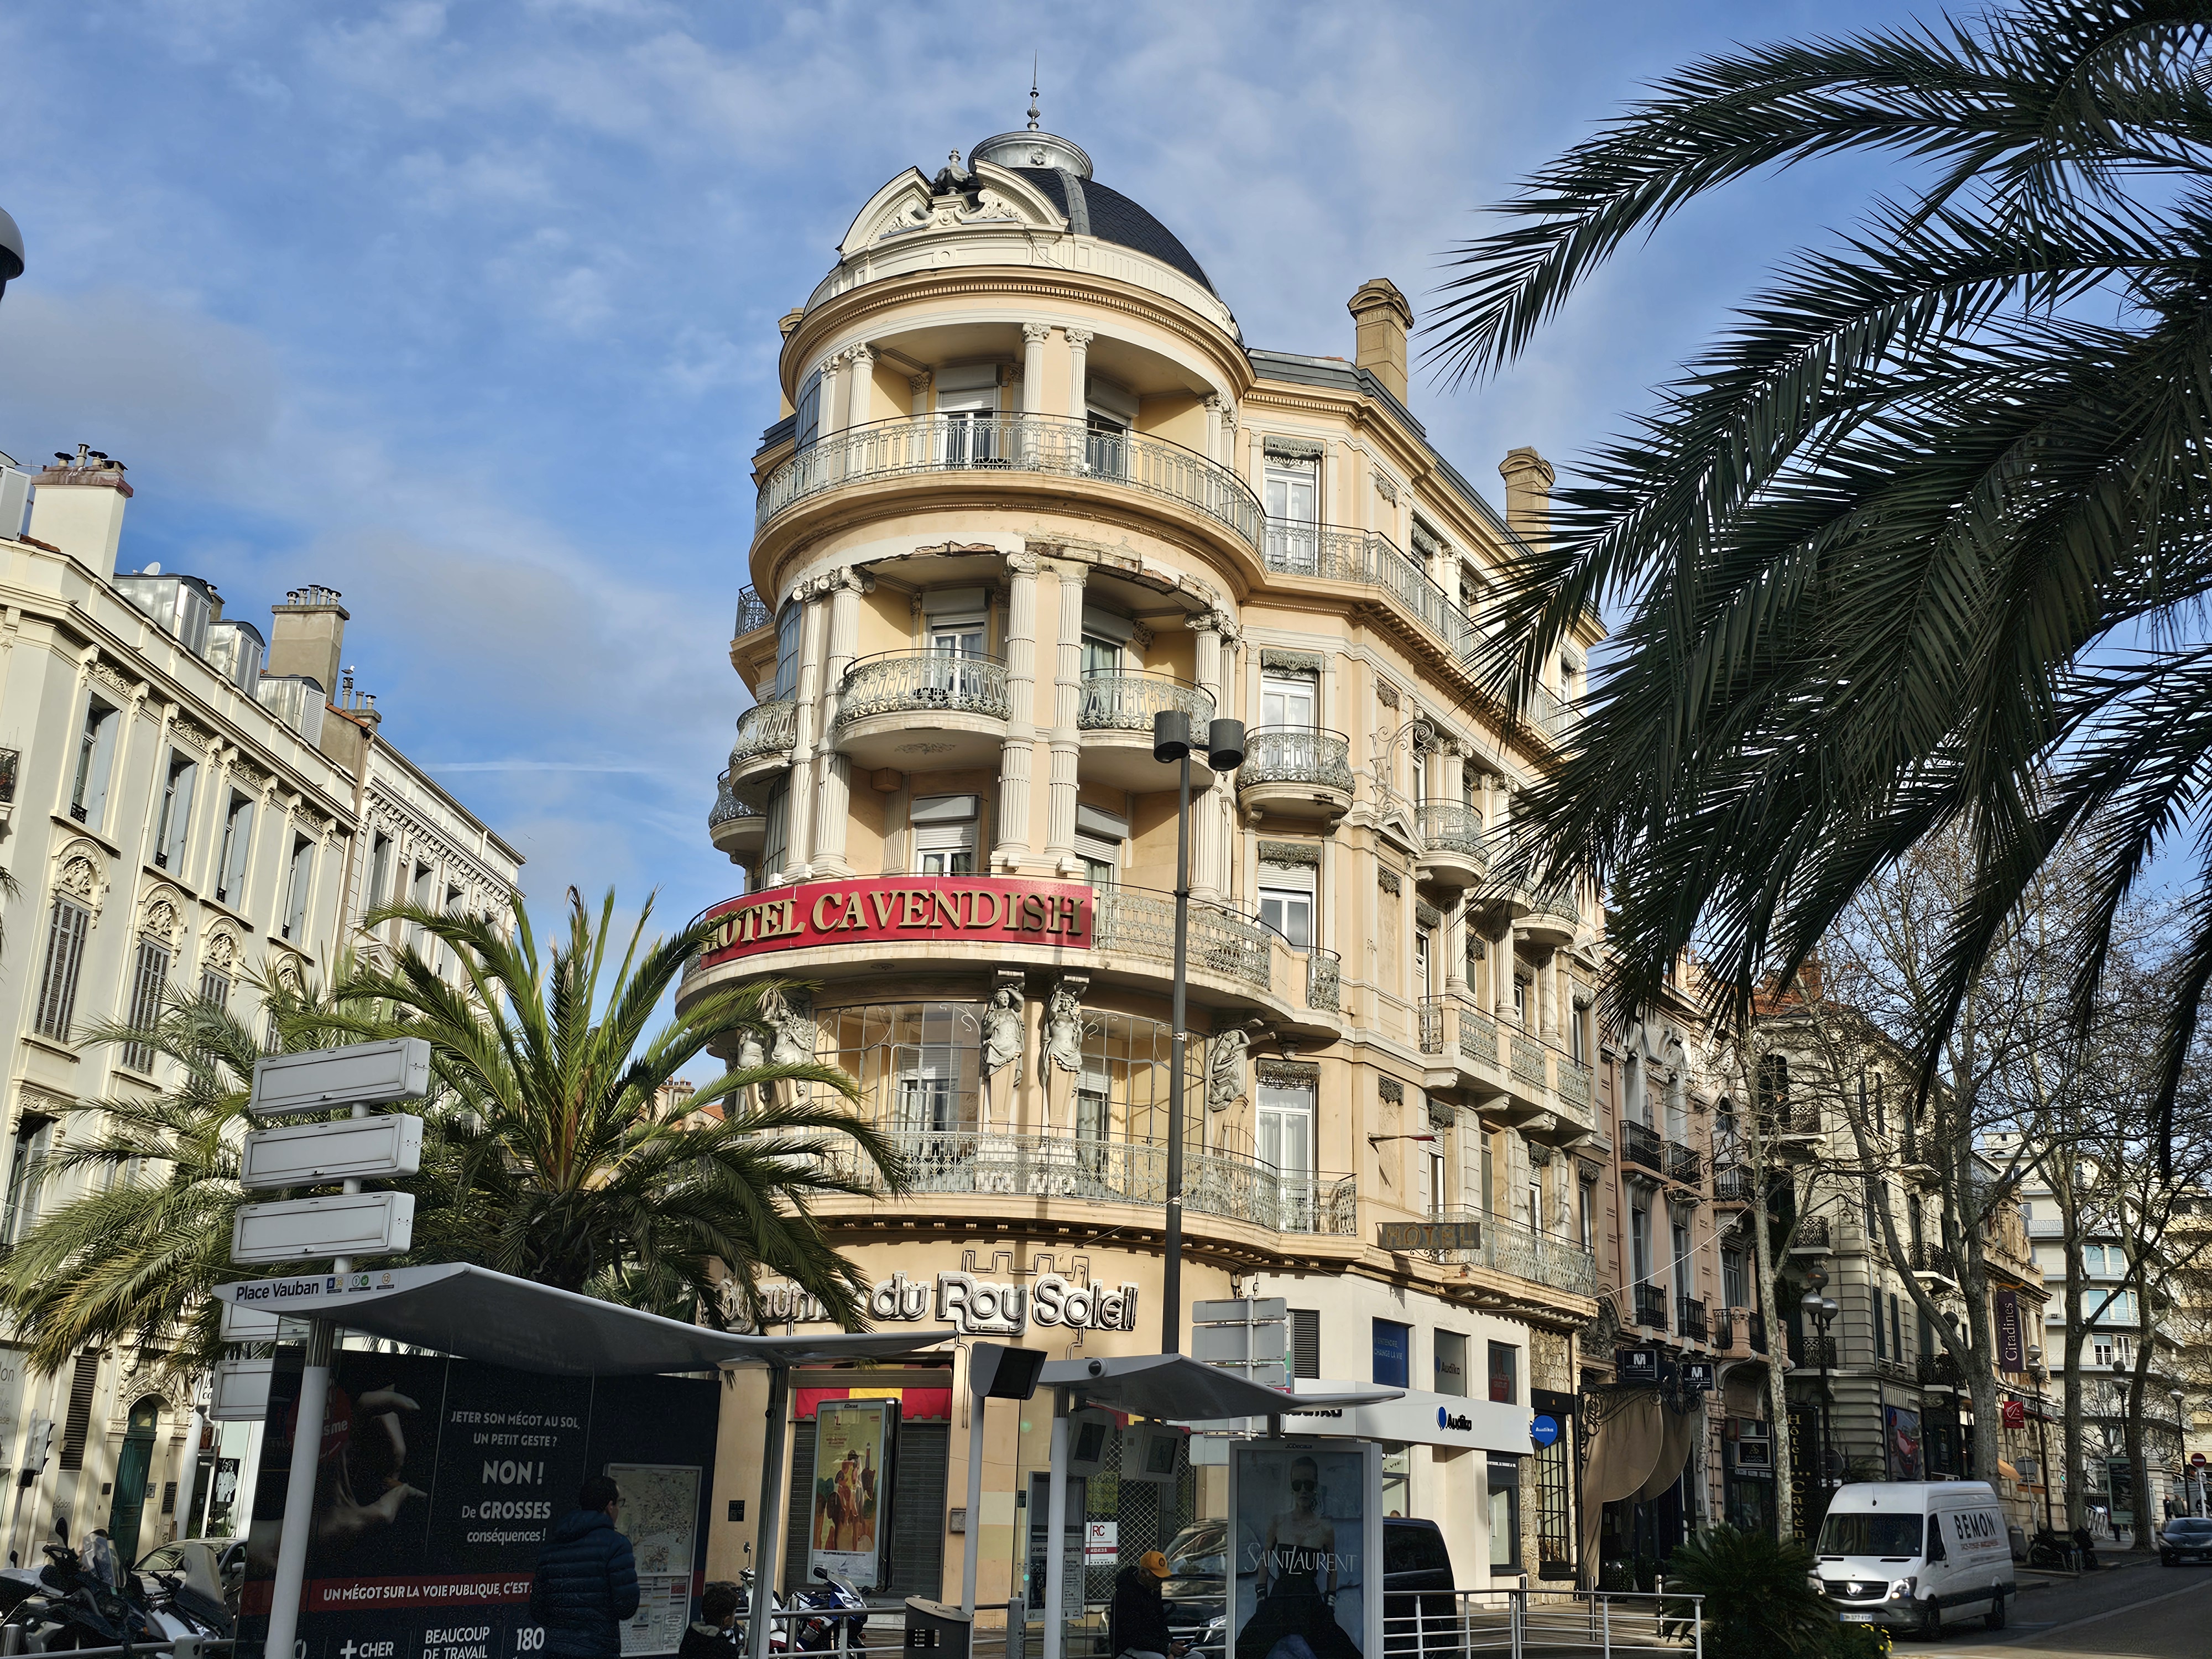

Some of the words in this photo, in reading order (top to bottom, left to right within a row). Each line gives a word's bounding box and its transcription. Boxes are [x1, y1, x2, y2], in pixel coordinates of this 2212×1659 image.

[812, 889, 1086, 935] CAVENDISH
[236, 1285, 269, 1301] Place
[273, 1281, 319, 1297] Vauban
[872, 1271, 932, 1321] du
[936, 1271, 1029, 1335] Roy
[1033, 1272, 1139, 1331] Soleil
[2002, 1303, 2017, 1361] Citadines
[451, 1411, 481, 1423] JETER
[483, 1413, 505, 1425] SON
[508, 1411, 542, 1426] MÉGOT
[544, 1416, 558, 1427] AU
[560, 1416, 581, 1430] SOL,
[473, 1432, 488, 1444] UN
[491, 1433, 519, 1446] PETIT
[521, 1434, 550, 1447] GESTE
[1787, 1414, 1802, 1465] Hôtel
[482, 1460, 533, 1484] NON
[462, 1506, 476, 1519] De
[479, 1501, 551, 1520] GROSSES
[467, 1527, 540, 1546] conséquences
[324, 1588, 341, 1601] UN
[343, 1584, 383, 1600] MÉGOT
[383, 1585, 404, 1598] SUR
[407, 1585, 420, 1598] LA
[422, 1584, 447, 1597] VOIE
[449, 1582, 502, 1597] PUBLIQUE,
[425, 1626, 490, 1644] BEAUCOUP
[516, 1627, 545, 1651] 180
[359, 1642, 394, 1658] CHER
[423, 1648, 439, 1659] DE
[443, 1645, 488, 1659] TRAVAIL
